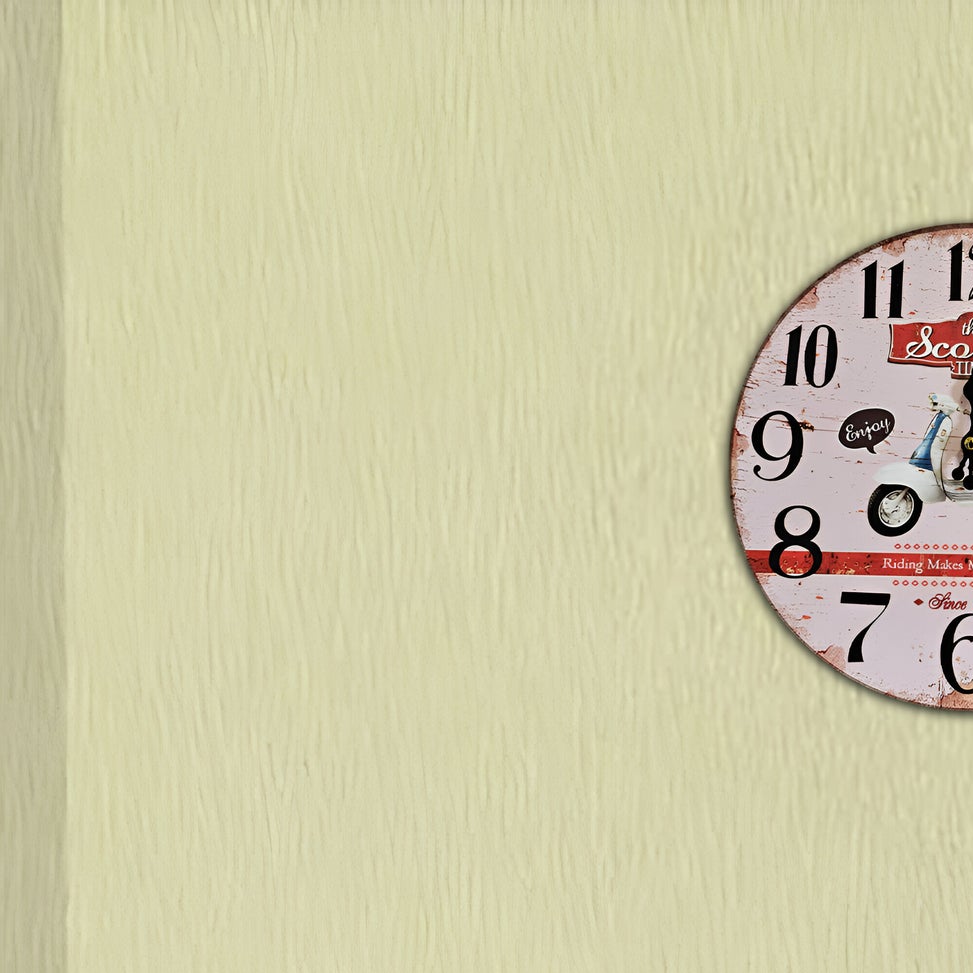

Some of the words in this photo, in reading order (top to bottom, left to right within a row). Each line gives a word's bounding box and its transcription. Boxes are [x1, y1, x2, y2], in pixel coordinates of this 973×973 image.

[862, 261, 904, 319] 11
[784, 324, 838, 388] 10
[751, 410, 803, 481] 9
[845, 418, 891, 442] Enjoy
[768, 505, 823, 578] 8
[882, 558, 923, 573] Riding
[927, 559, 964, 570] Makes
[840, 591, 890, 663] 7
[928, 592, 968, 611] Since
